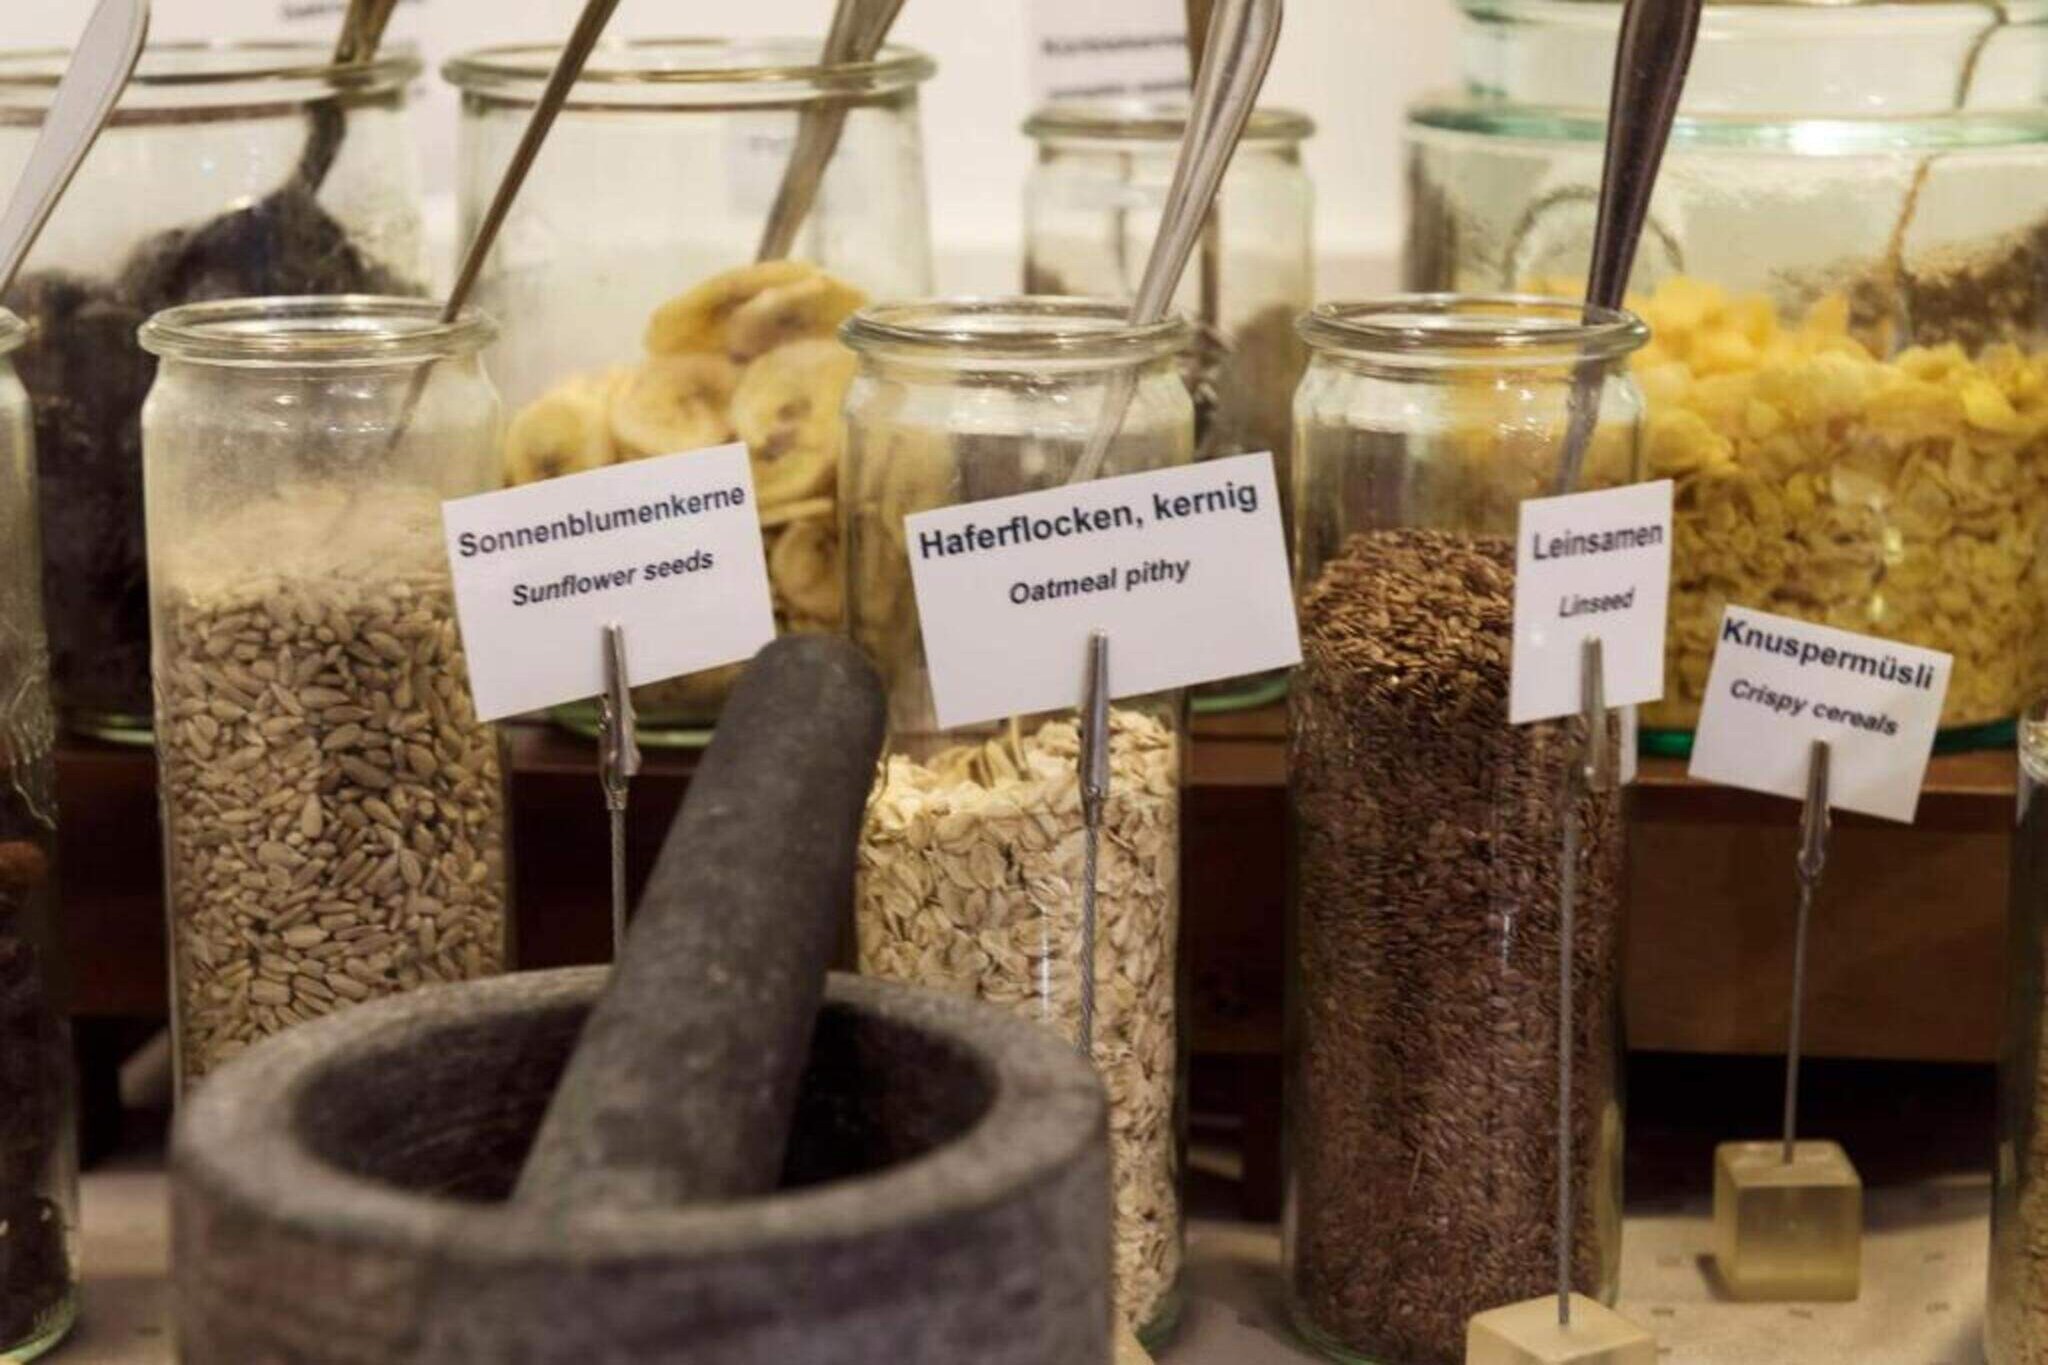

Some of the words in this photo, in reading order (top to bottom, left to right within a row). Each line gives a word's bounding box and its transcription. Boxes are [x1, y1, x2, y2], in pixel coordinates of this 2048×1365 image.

[458, 486, 745, 557] Sonnenblumenkerne
[919, 504, 1143, 559] Haferflocken,
[1153, 482, 1257, 521] kernig
[1533, 524, 1664, 560] Leinsamen
[512, 566, 637, 606] Sunflower
[643, 549, 714, 581] seeds
[1009, 568, 1117, 605] Oatmeal
[1125, 559, 1190, 592] pithy
[1559, 586, 1635, 618] Linseed
[1722, 617, 1934, 690] Knuspermüsli
[1730, 679, 1808, 717] Crispy
[1813, 702, 1898, 736] cereals
